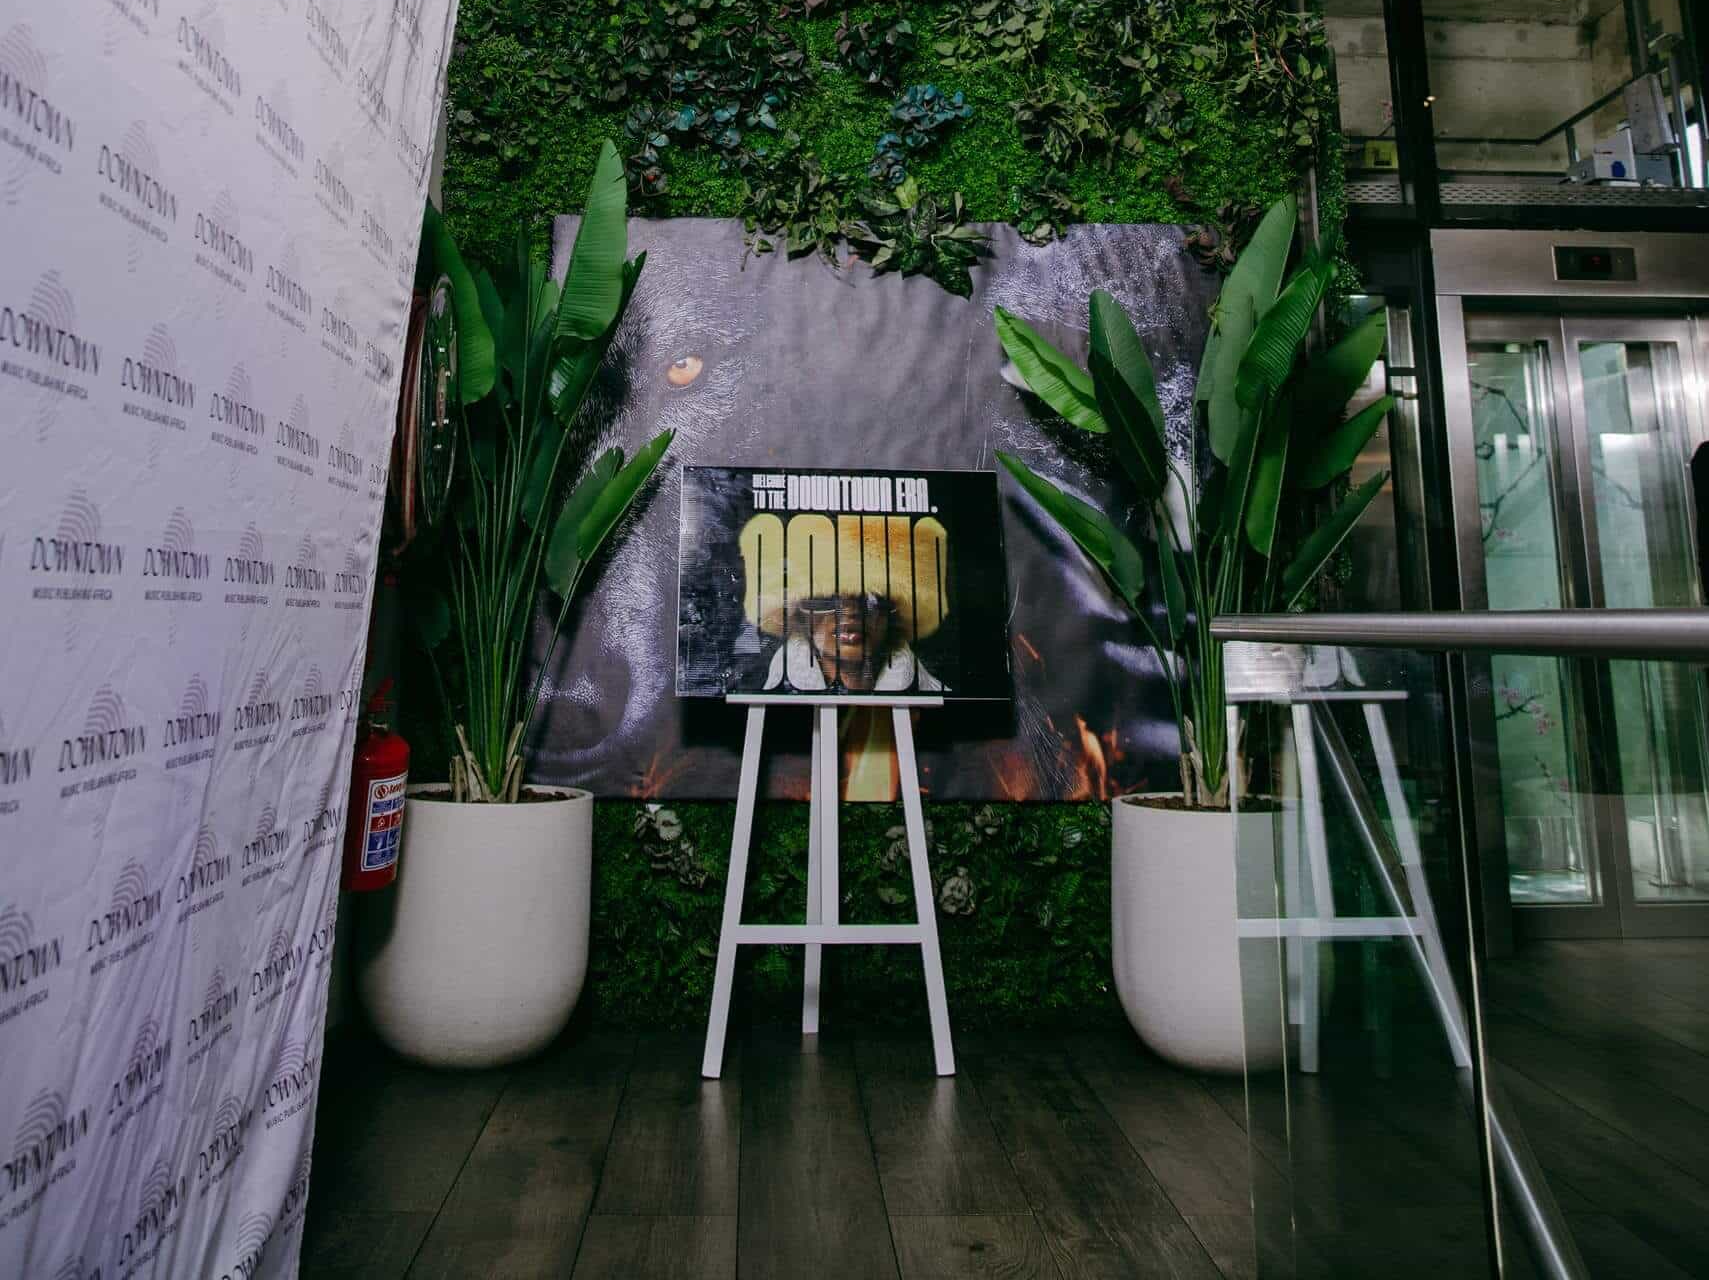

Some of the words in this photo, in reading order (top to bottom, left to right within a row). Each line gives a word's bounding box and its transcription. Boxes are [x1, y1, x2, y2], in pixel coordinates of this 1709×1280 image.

[178, 16, 241, 98] DOWNTOWN
[97, 144, 178, 224] DOWNTOWN
[194, 211, 254, 276] DOWNTOWN
[265, 264, 312, 317] DOWNTOWN
[0, 306, 101, 376] DOWNTOWN
[120, 357, 196, 408] DOWNTOWN
[209, 392, 265, 436] DOWNTOWN
[276, 420, 320, 458] DOWNTOWN
[328, 444, 363, 477] DOWNTOWN
[752, 489, 767, 510] TO
[767, 489, 786, 510] THE
[786, 474, 893, 513] DOWNTOWN
[895, 477, 938, 514] ERA.
[31, 536, 124, 574] DOWNTOWN
[143, 548, 209, 580] DOWNTOWN
[224, 556, 274, 584] DOWNTOWN
[285, 565, 326, 591] DOWNTOWN
[234, 700, 280, 732] DOWNTOWN
[290, 693, 332, 720] DOWNTOWN
[57, 724, 145, 772] DOWNTOWN
[163, 712, 221, 748] DOWNTOWN
[241, 830, 289, 869] DOWNTOWN
[177, 855, 231, 903] DOWNTOWN
[86, 888, 161, 952] DOWNTOWN
